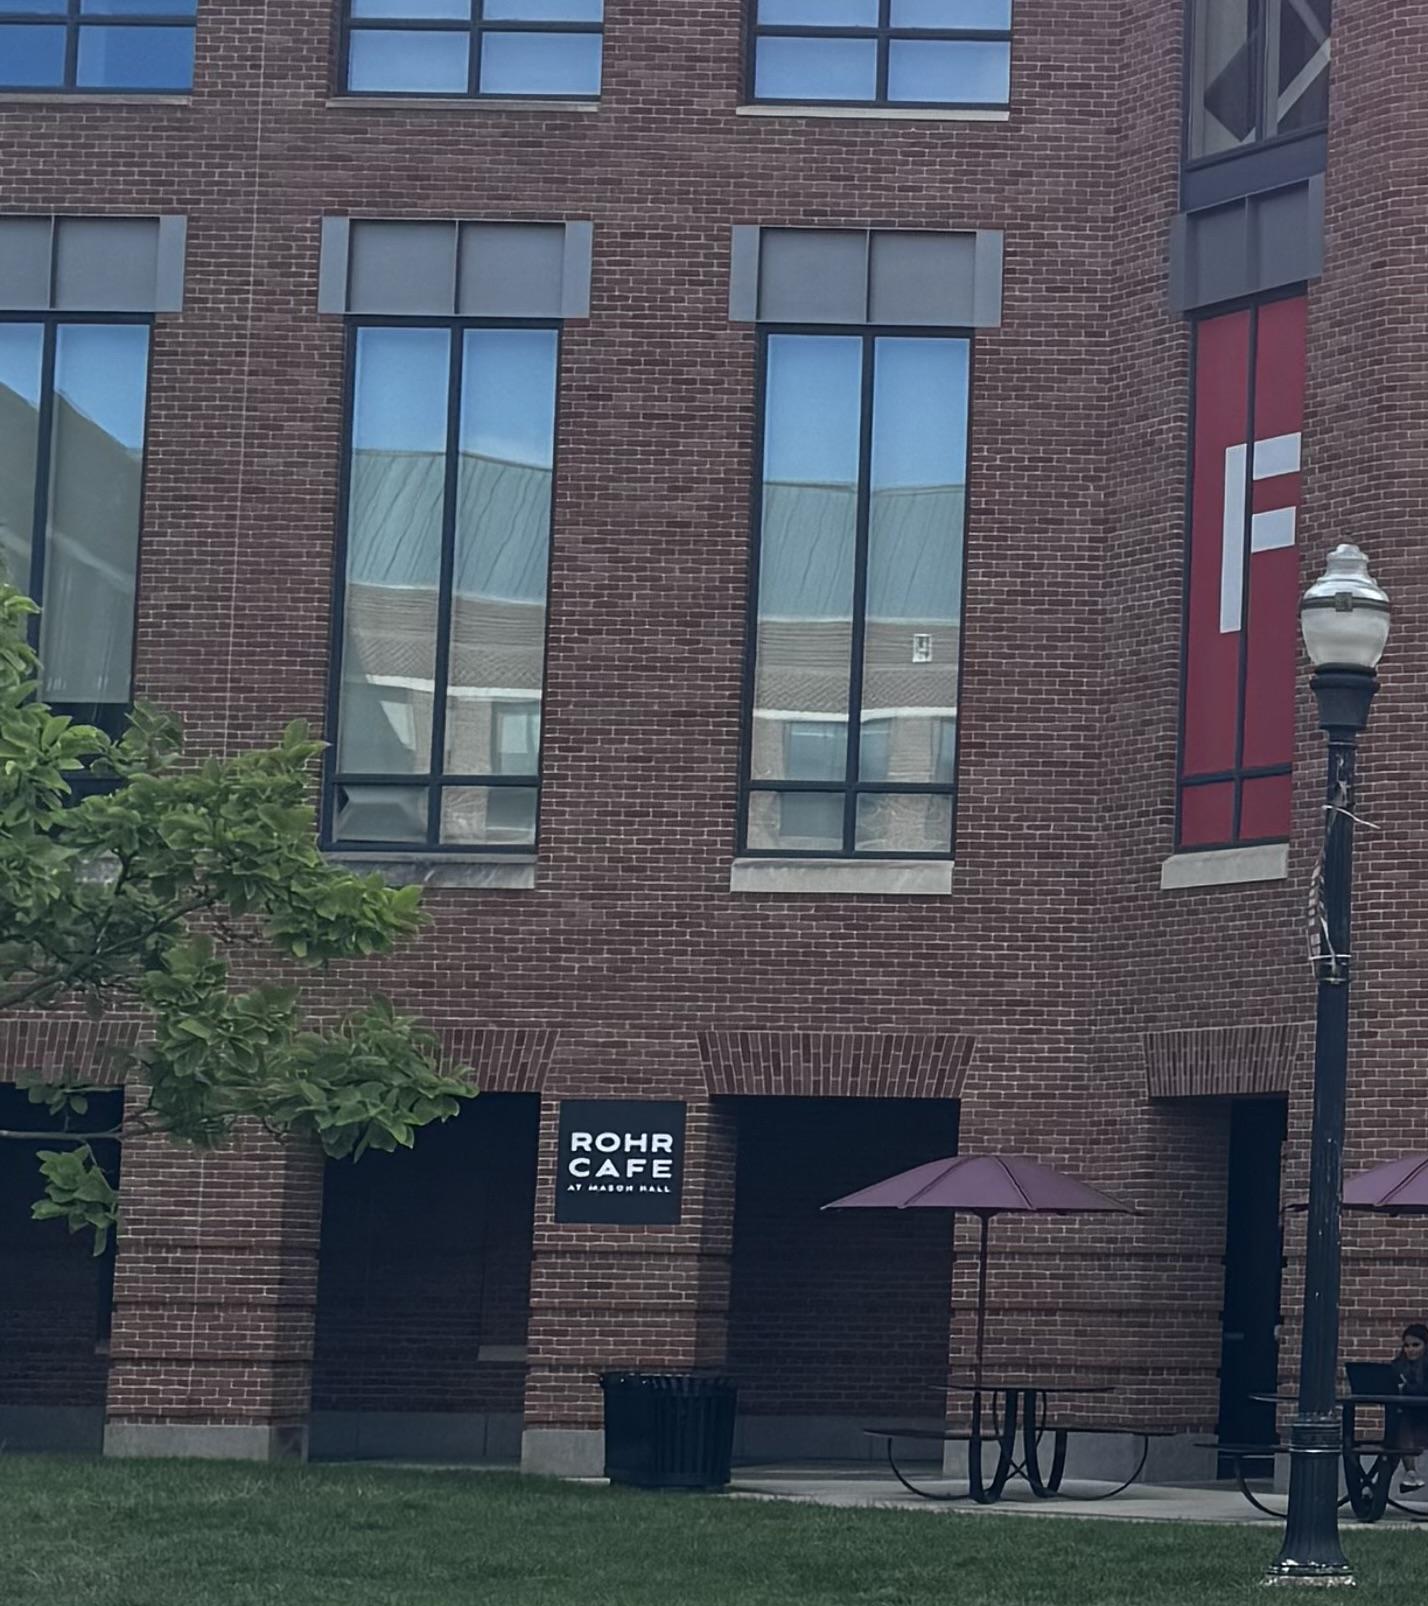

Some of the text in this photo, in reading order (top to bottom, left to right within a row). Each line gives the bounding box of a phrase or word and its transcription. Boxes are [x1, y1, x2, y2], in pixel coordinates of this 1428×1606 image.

[571, 1132, 673, 1152] ROHR
[568, 1157, 673, 1178] CAFE
[588, 1184, 633, 1192] MASON
[639, 1184, 671, 1193] HALL
